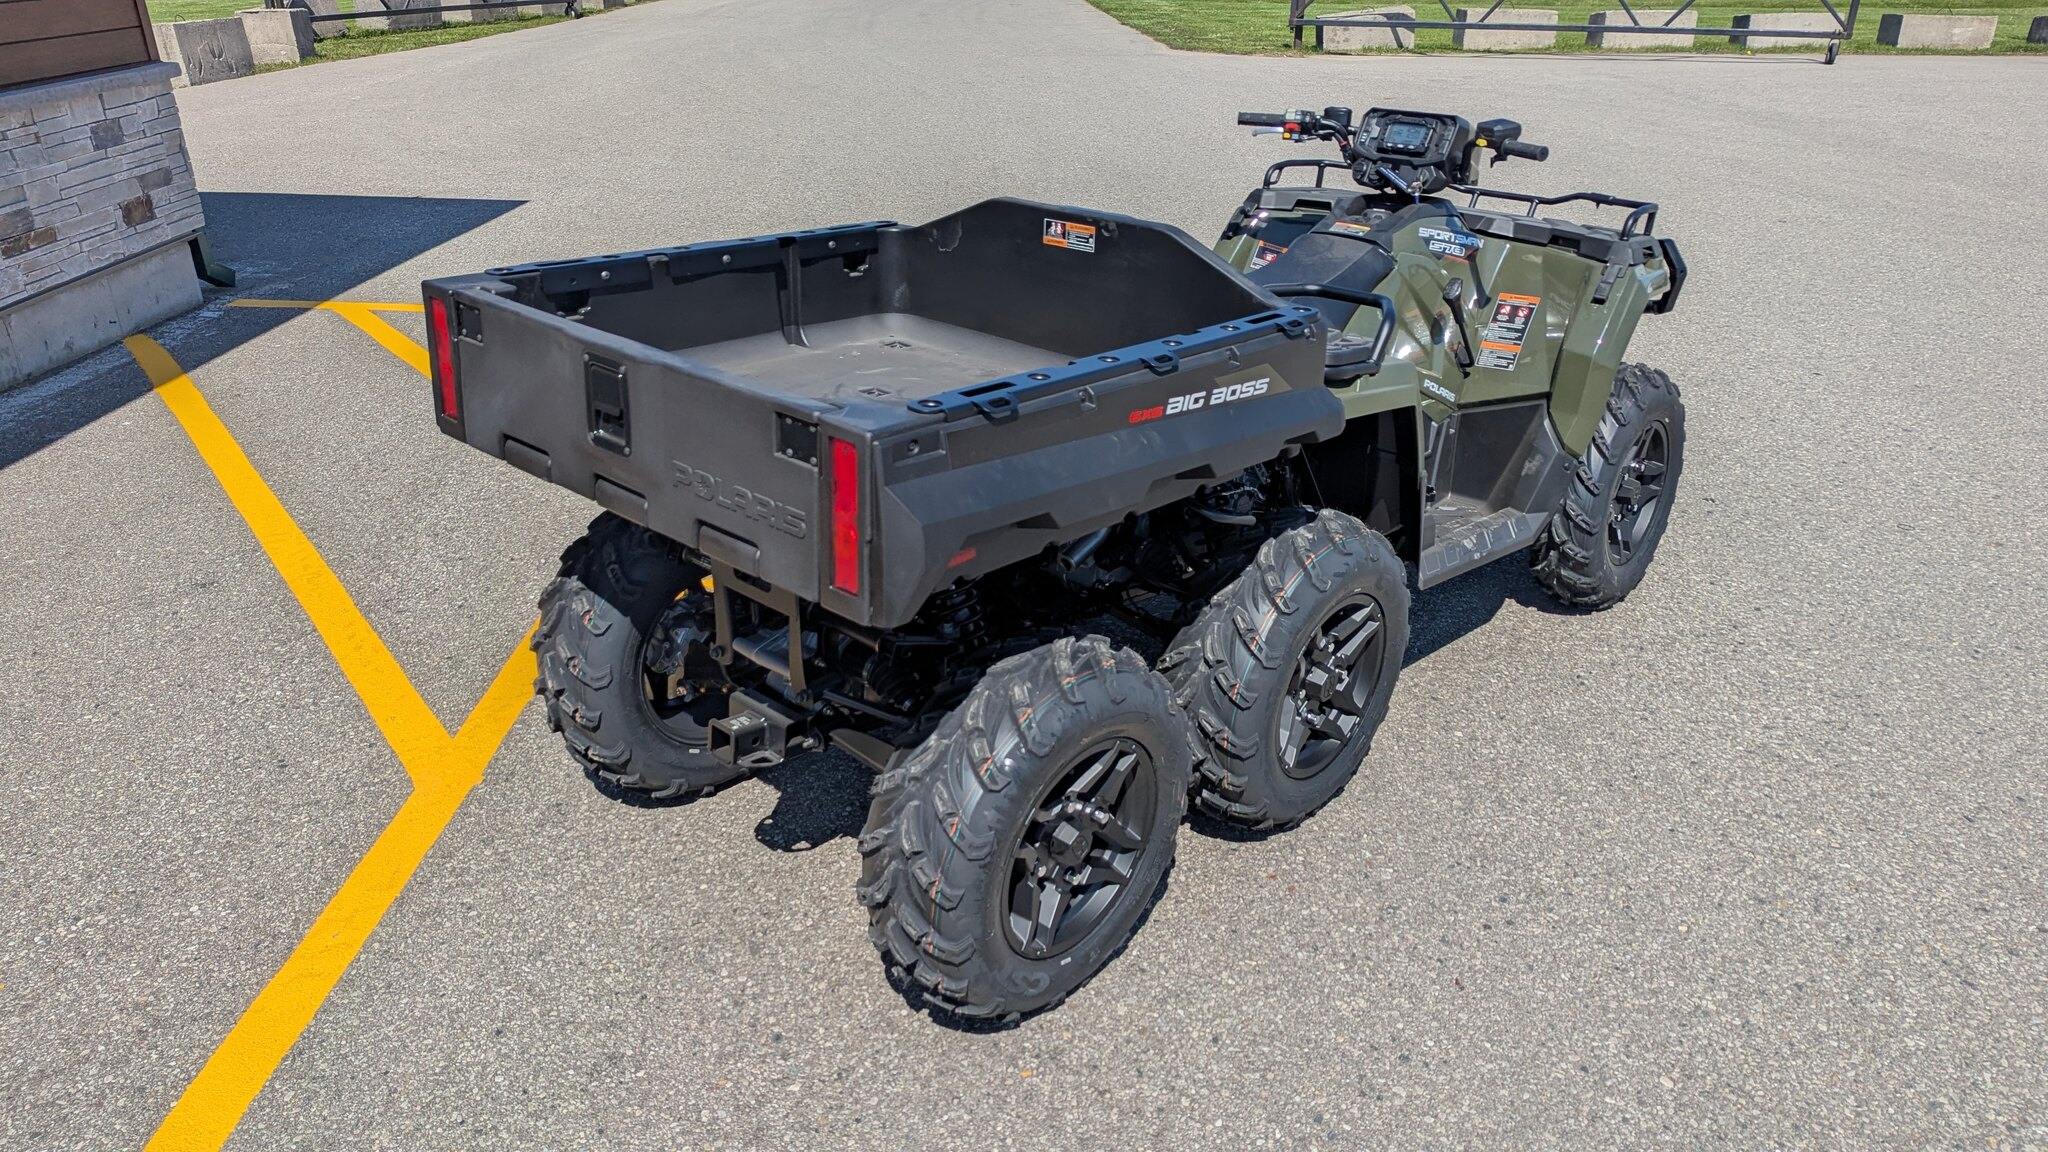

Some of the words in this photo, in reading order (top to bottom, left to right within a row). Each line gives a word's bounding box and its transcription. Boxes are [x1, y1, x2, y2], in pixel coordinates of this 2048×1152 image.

[1418, 227, 1485, 249] SPORTSMAN
[1165, 391, 1207, 415] BIG
[1209, 377, 1270, 406] BOSS
[1423, 378, 1456, 403] POLARIS
[672, 459, 807, 540] POLARIS
